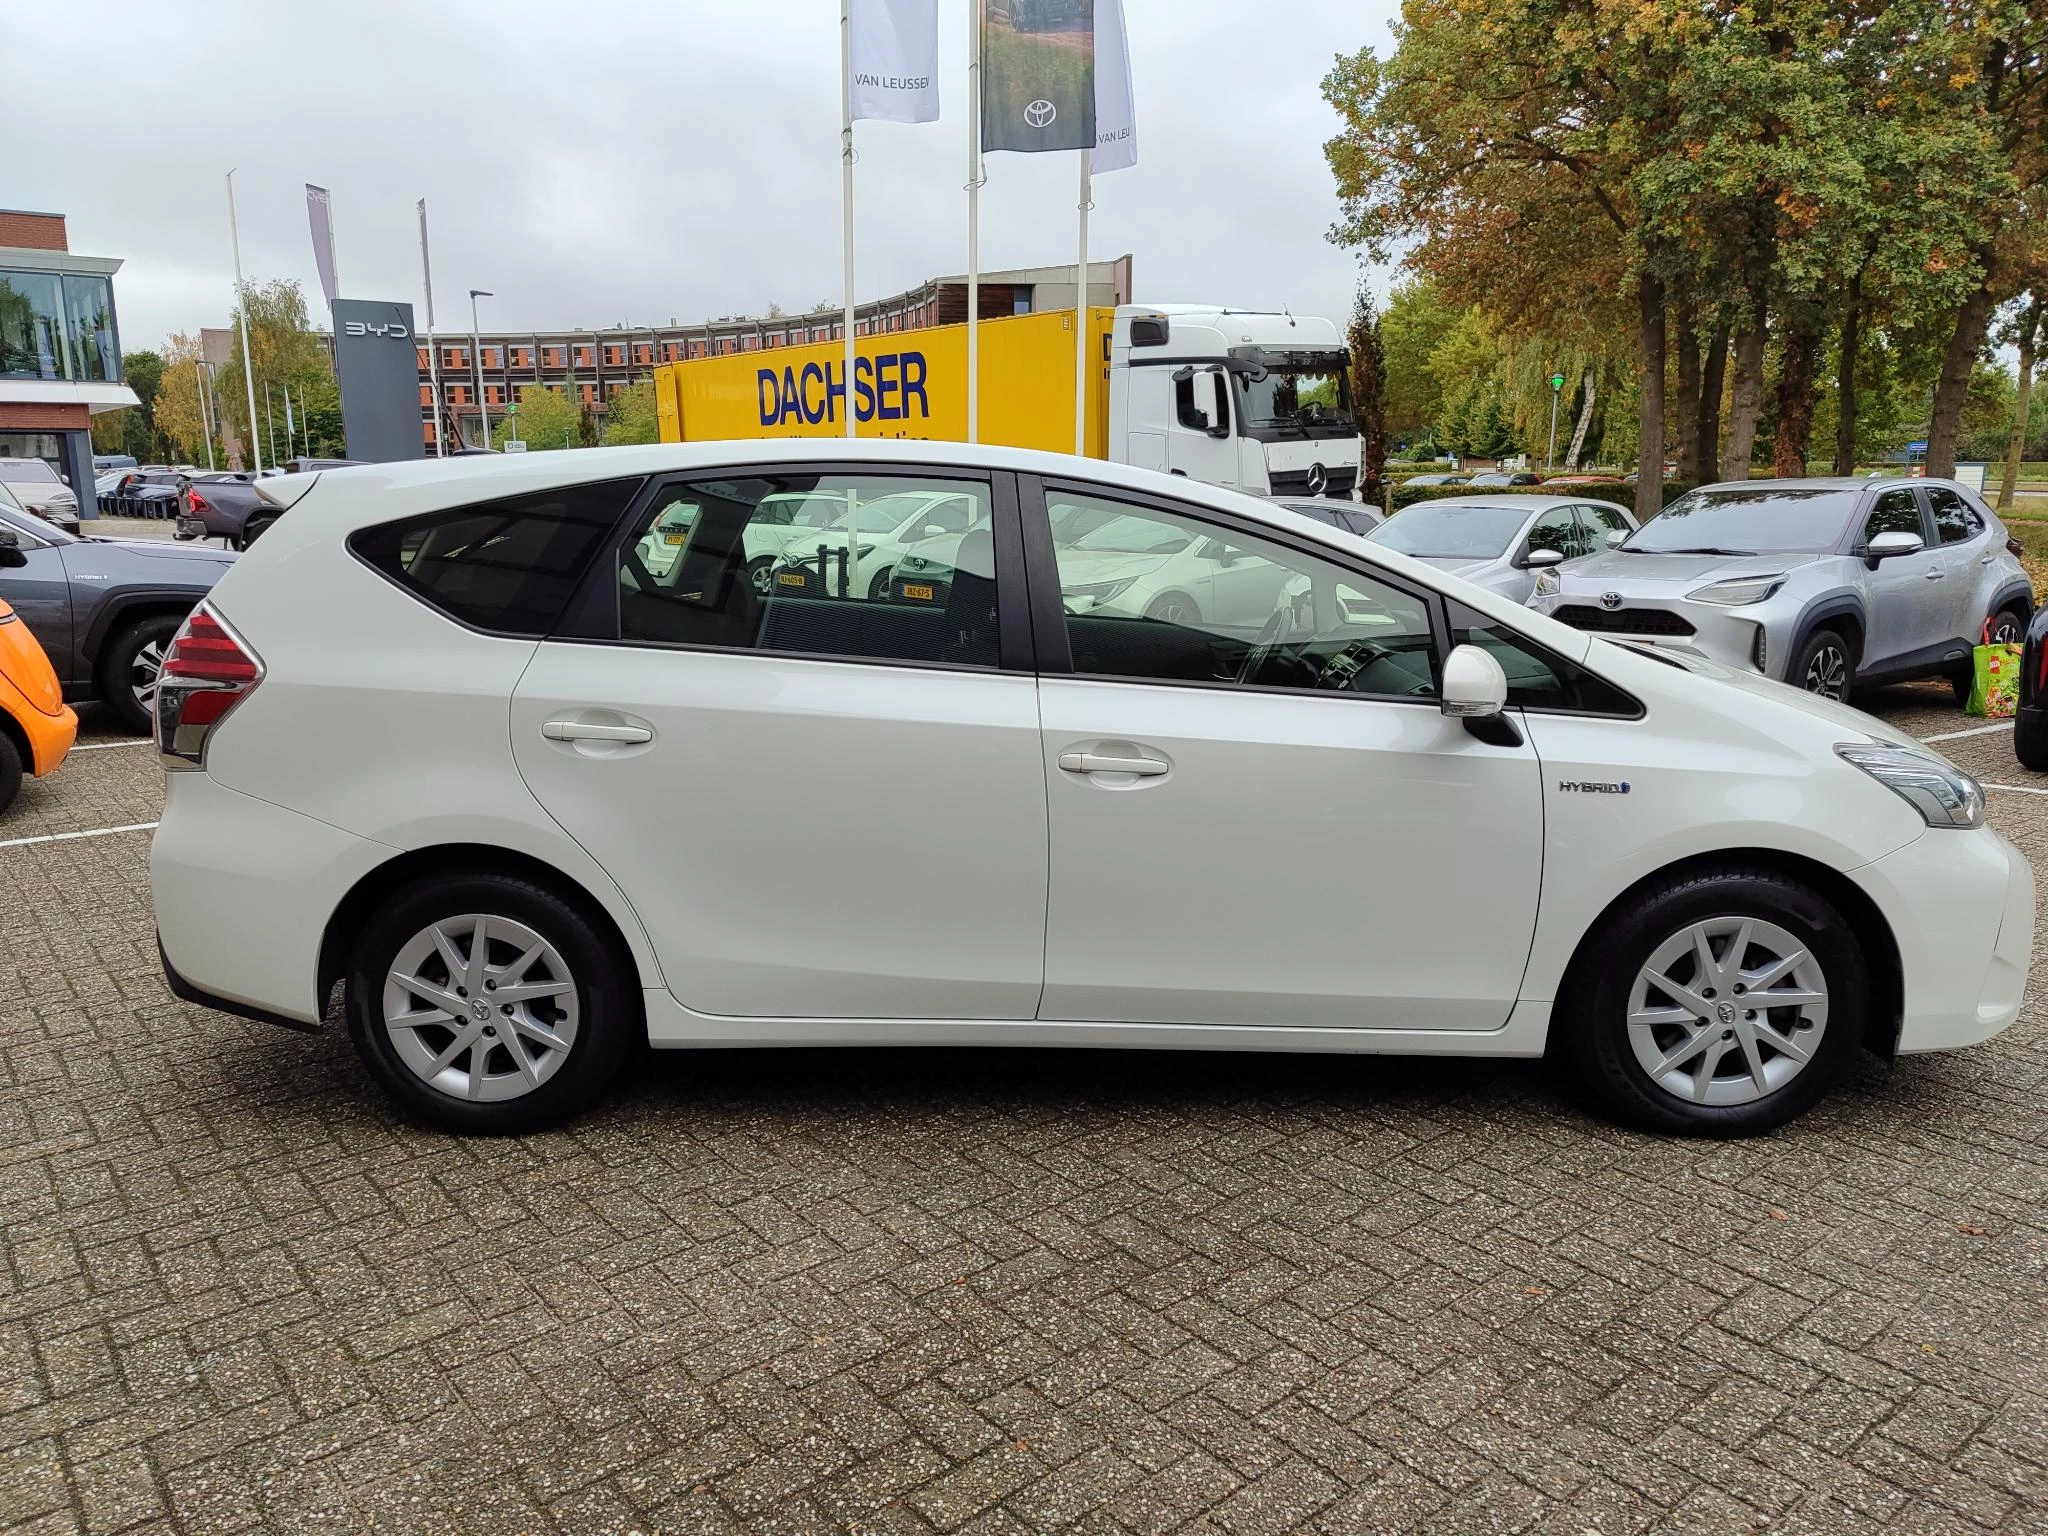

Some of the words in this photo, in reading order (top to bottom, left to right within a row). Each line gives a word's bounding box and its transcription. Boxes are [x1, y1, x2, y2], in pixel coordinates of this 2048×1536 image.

[855, 74, 879, 87] VAN
[1098, 131, 1116, 144] VAN
[345, 321, 408, 338] BYD
[757, 351, 930, 427] DACHSER
[1559, 780, 1620, 794] HYBRID
